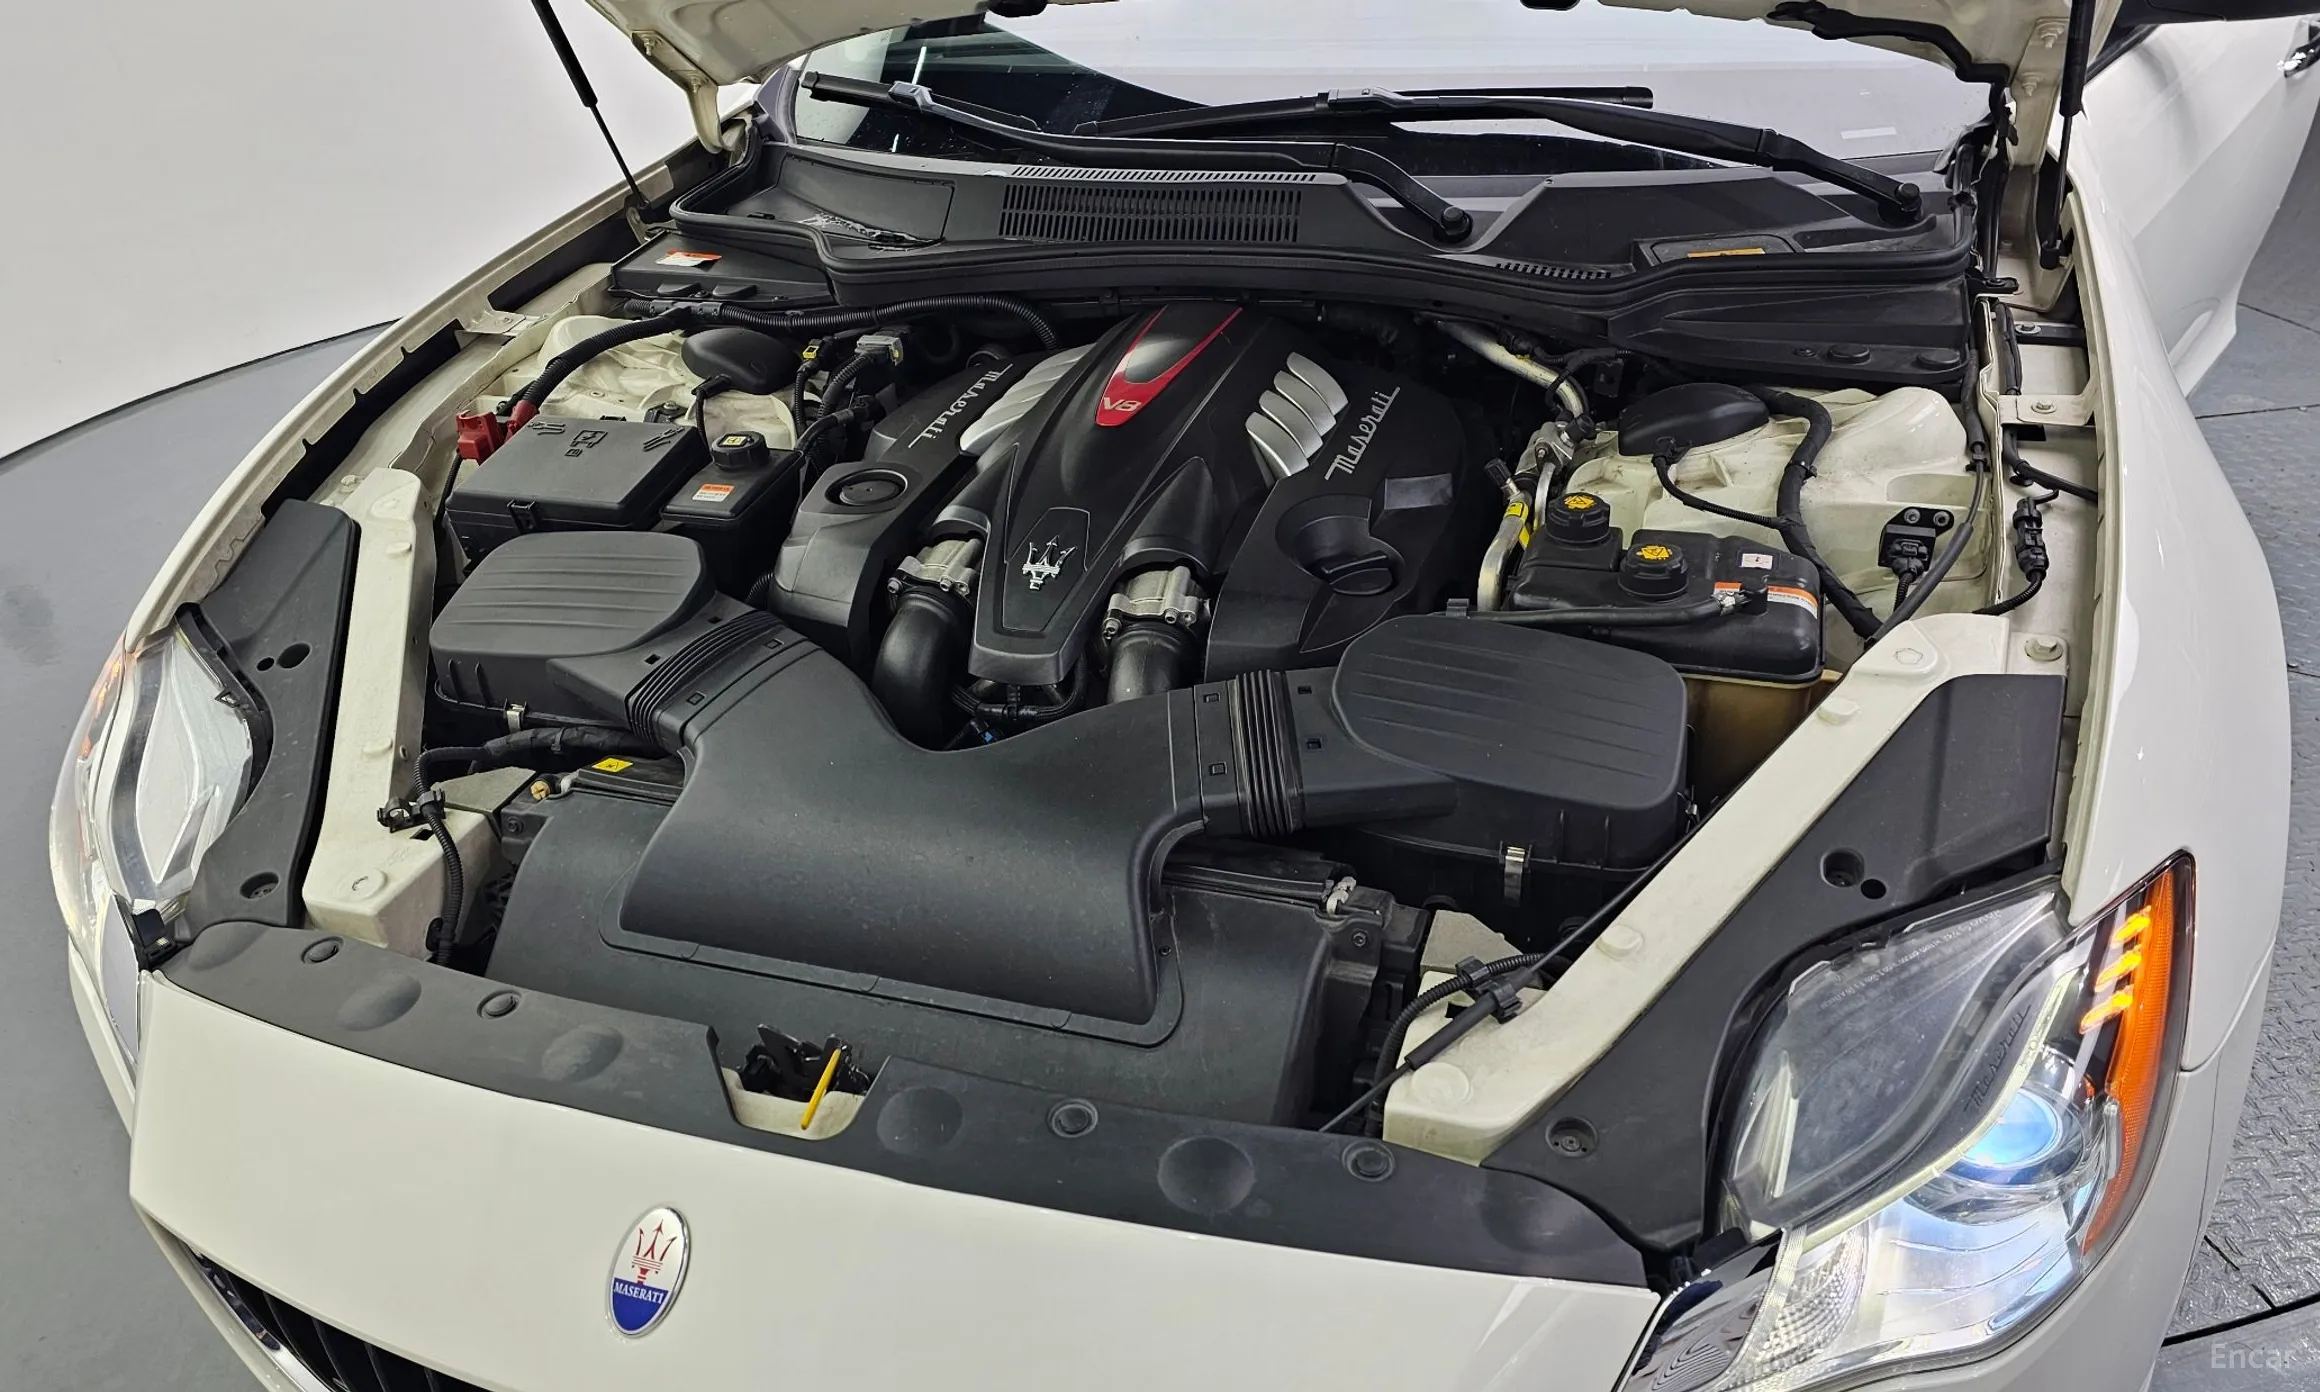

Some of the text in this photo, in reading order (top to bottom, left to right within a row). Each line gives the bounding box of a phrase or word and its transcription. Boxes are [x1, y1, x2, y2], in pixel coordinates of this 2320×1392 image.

[908, 363, 1013, 449] Maserati
[1103, 396, 1142, 412] V8
[1324, 386, 1401, 481] Maserati
[613, 1281, 665, 1304] MASERATI
